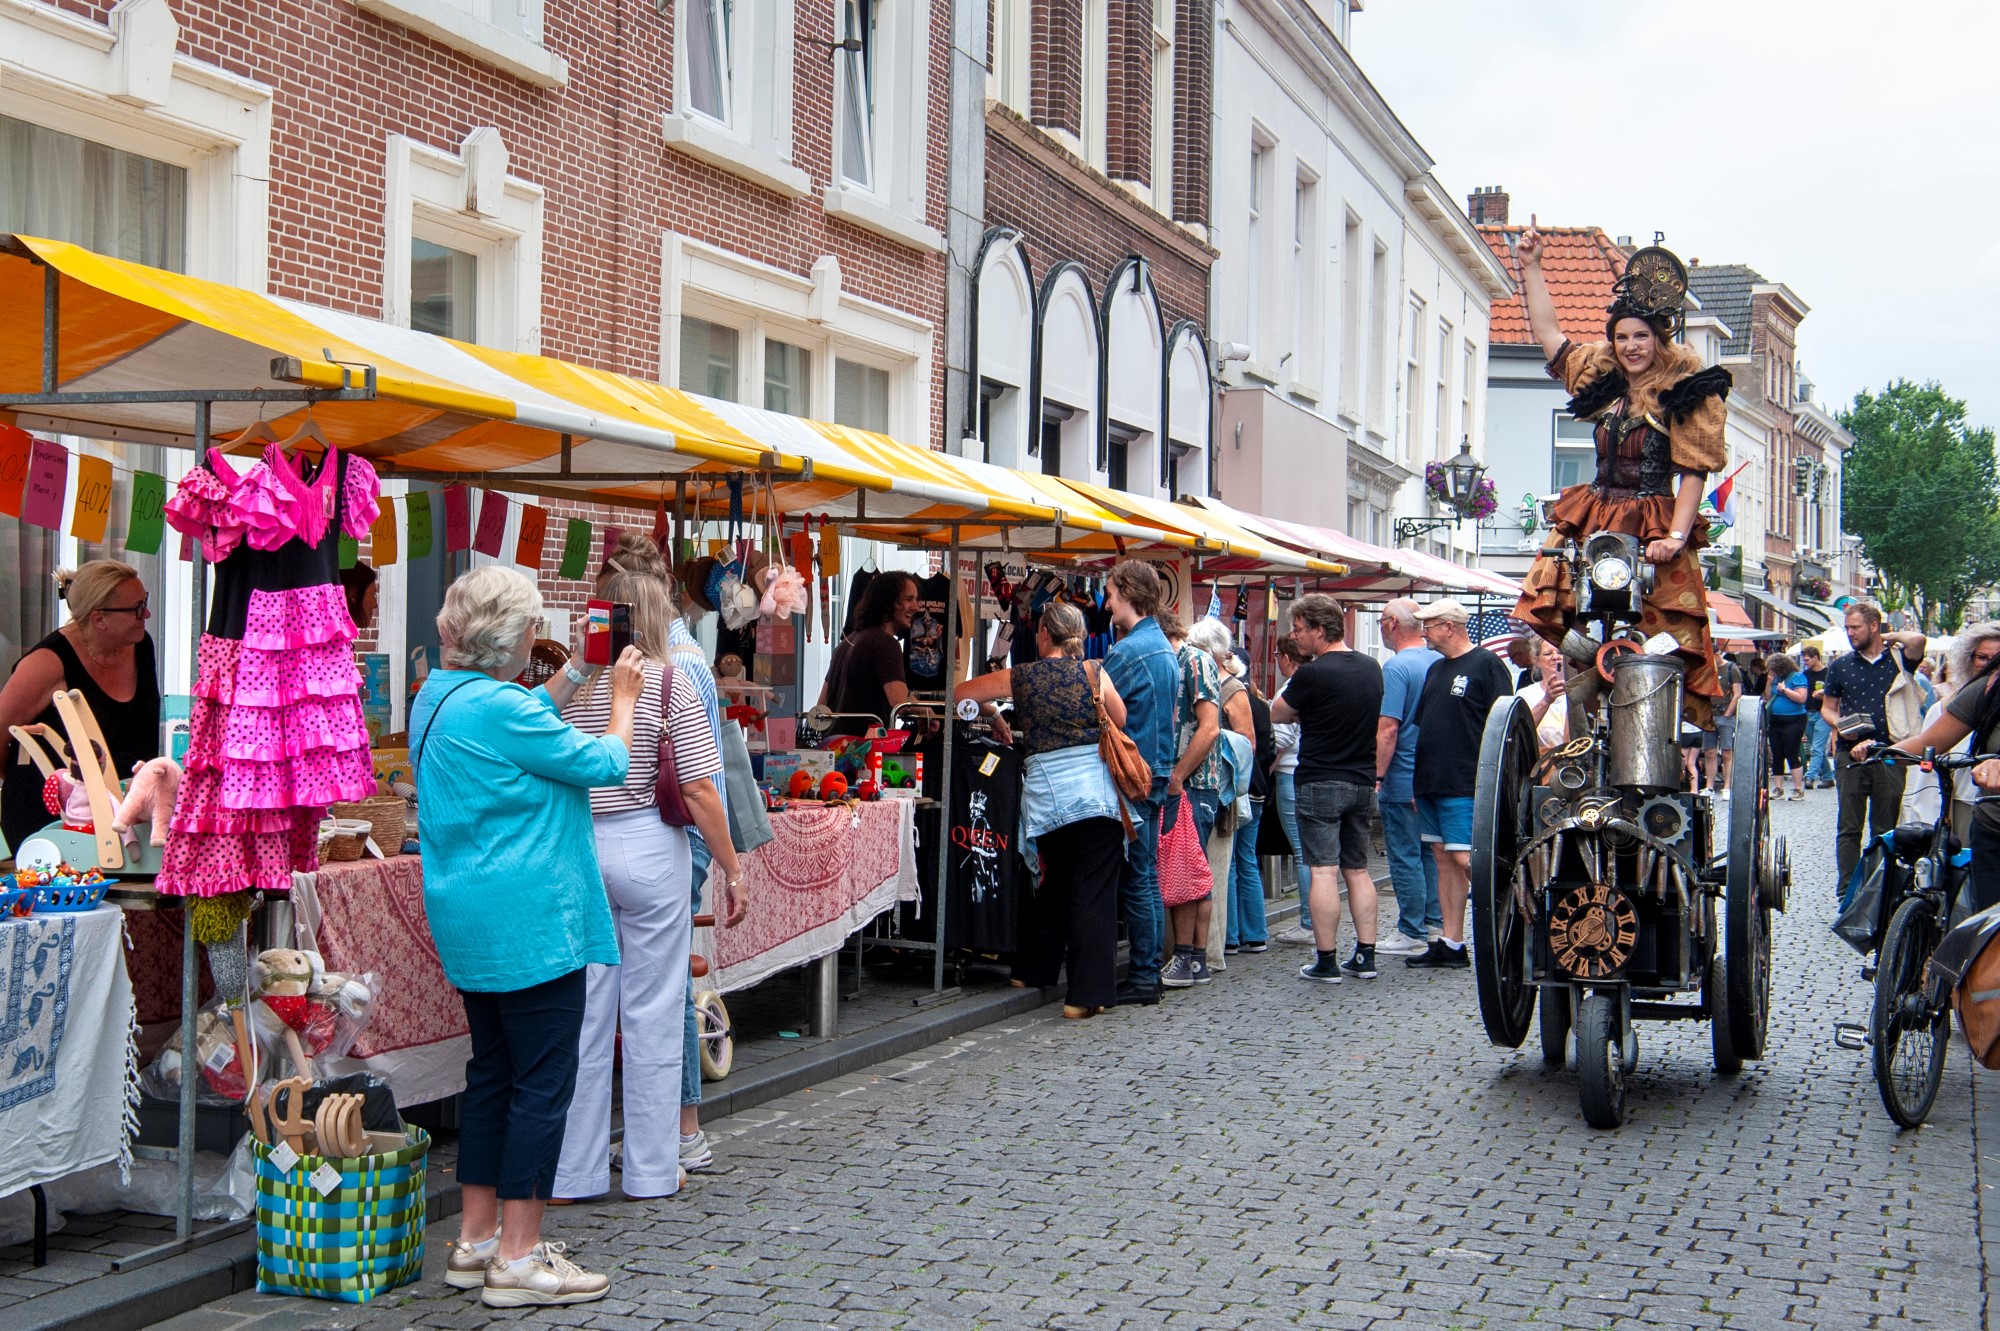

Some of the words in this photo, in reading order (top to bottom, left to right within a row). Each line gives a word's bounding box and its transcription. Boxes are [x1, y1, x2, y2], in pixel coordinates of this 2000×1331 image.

[79, 478, 111, 514] 40%
[132, 488, 165, 522] 40%
[374, 515, 396, 542] 40%
[479, 513, 504, 537] 40%
[520, 520, 545, 546] 40%
[567, 535, 589, 558] 40%
[780, 632, 787, 648] 5
[951, 825, 1008, 850] QUEEN
